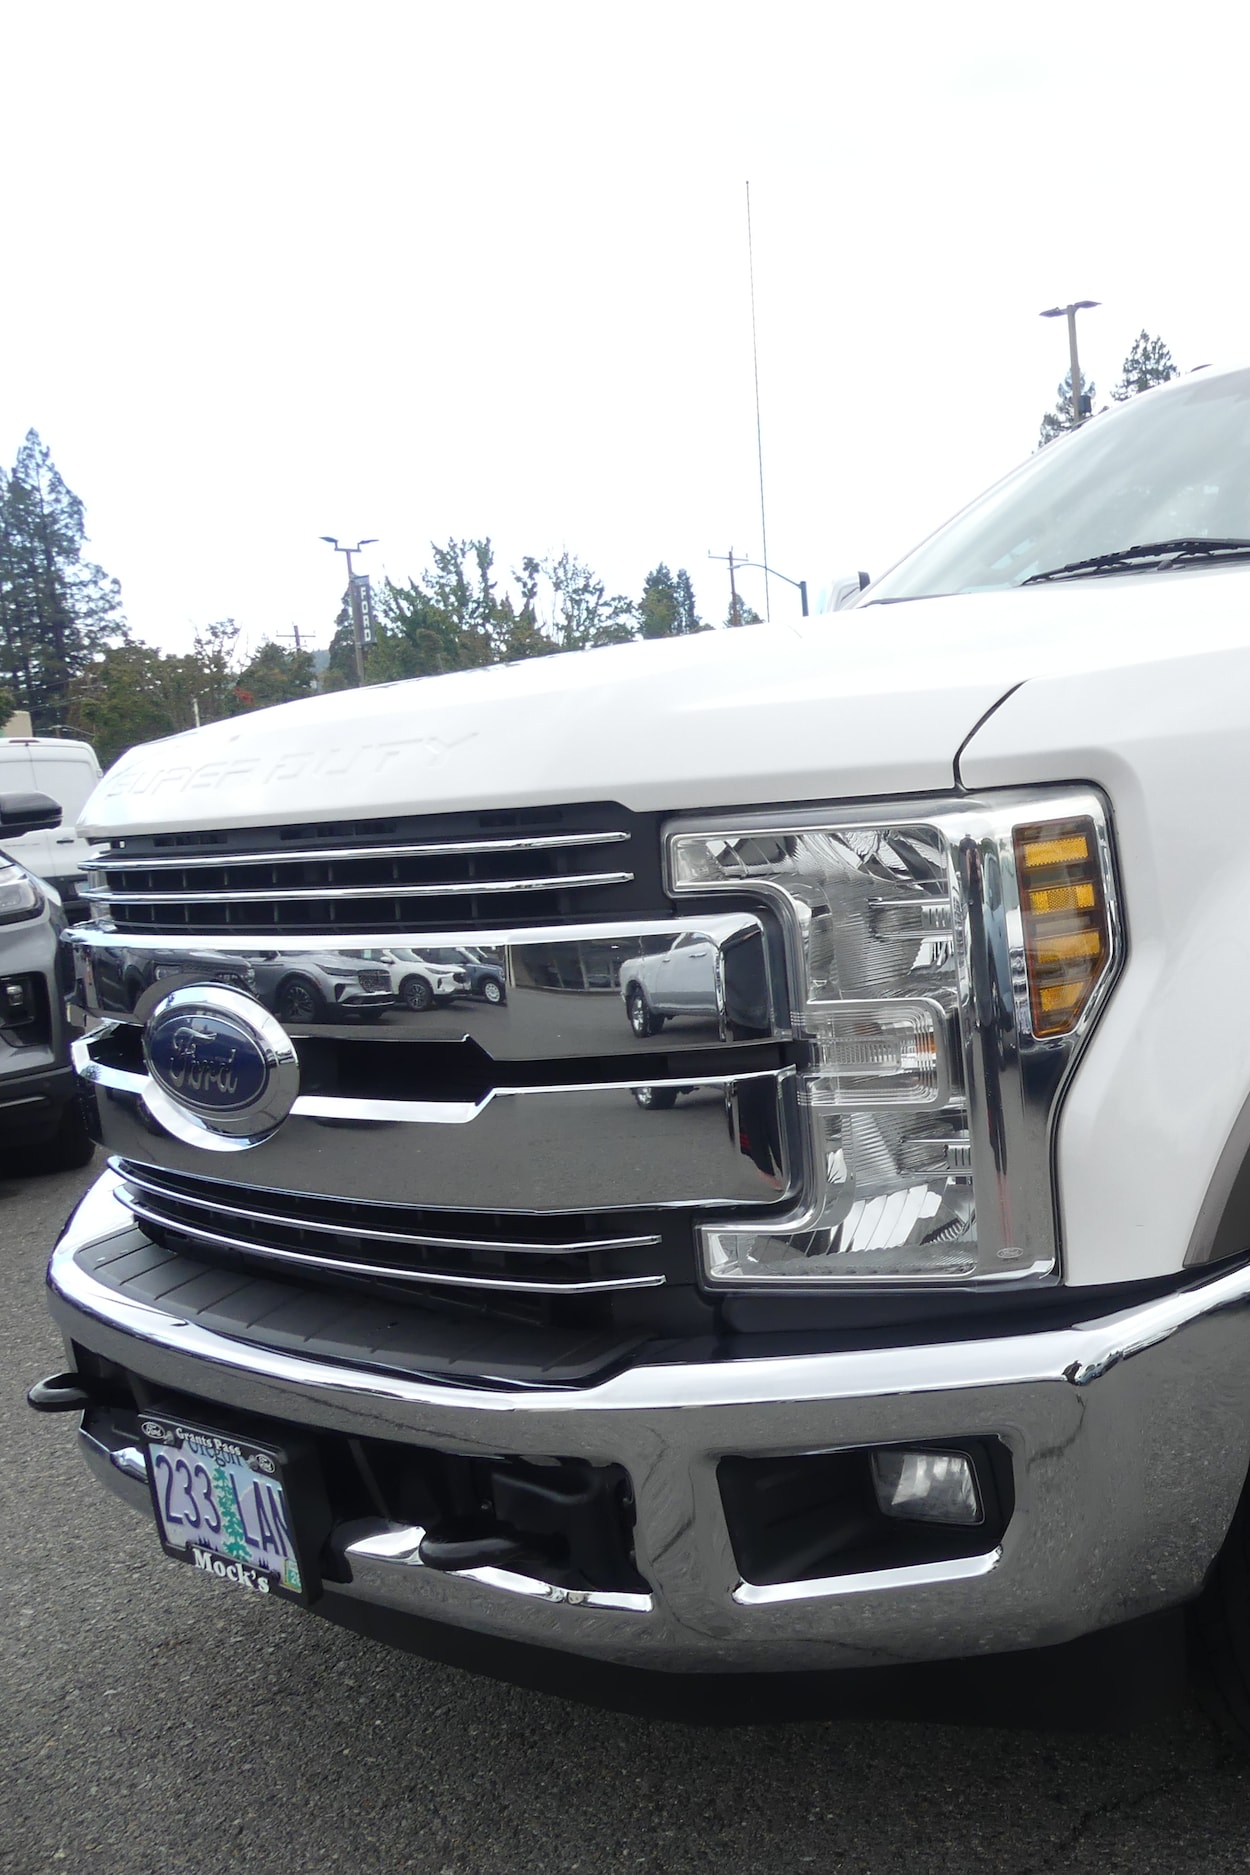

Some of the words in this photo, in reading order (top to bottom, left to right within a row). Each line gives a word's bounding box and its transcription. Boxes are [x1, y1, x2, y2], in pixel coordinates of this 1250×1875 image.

[360, 587, 372, 642] FORD
[105, 757, 262, 800] SUPER
[263, 731, 481, 786] DUTY
[169, 1026, 239, 1094] Ford
[175, 1427, 213, 1448] Grants
[212, 1438, 242, 1456] Pass
[155, 1453, 221, 1534] 233
[229, 1471, 290, 1558] LAN
[192, 1548, 270, 1594] Mock's
